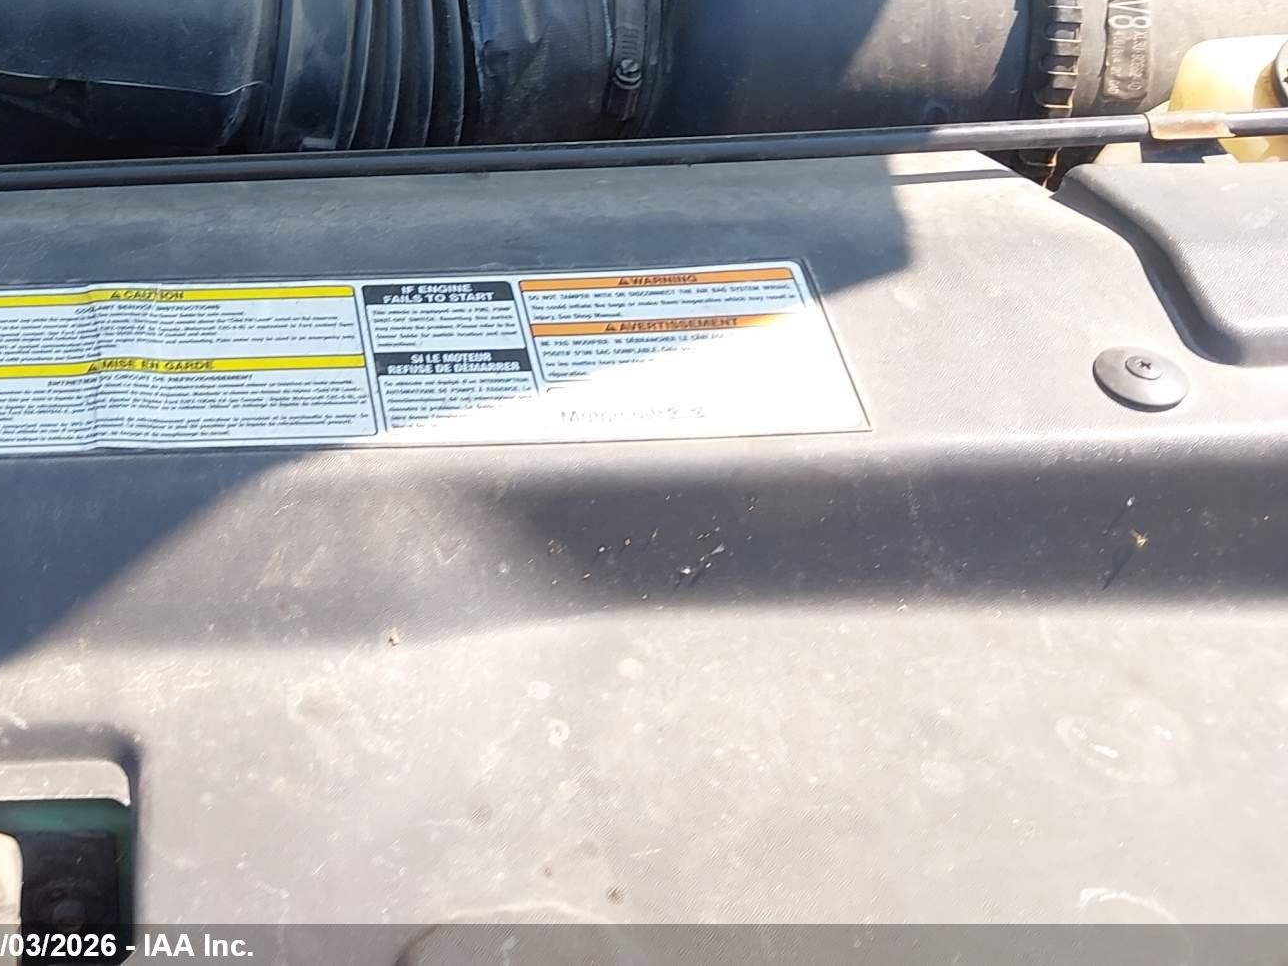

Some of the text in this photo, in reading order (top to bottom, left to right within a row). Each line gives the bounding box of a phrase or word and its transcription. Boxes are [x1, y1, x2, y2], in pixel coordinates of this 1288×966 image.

[632, 275, 697, 285] WARNING
[400, 283, 473, 294] IF ENGINE
[122, 291, 185, 301] CAUTION
[382, 292, 495, 304] FAILS TO START
[620, 317, 738, 331] AVERTISSEMENT
[410, 352, 492, 364] SI LE MOTEUR
[101, 359, 214, 370] MISE EN GARDE
[387, 364, 433, 375] REFUSE
[434, 363, 453, 373] DE
